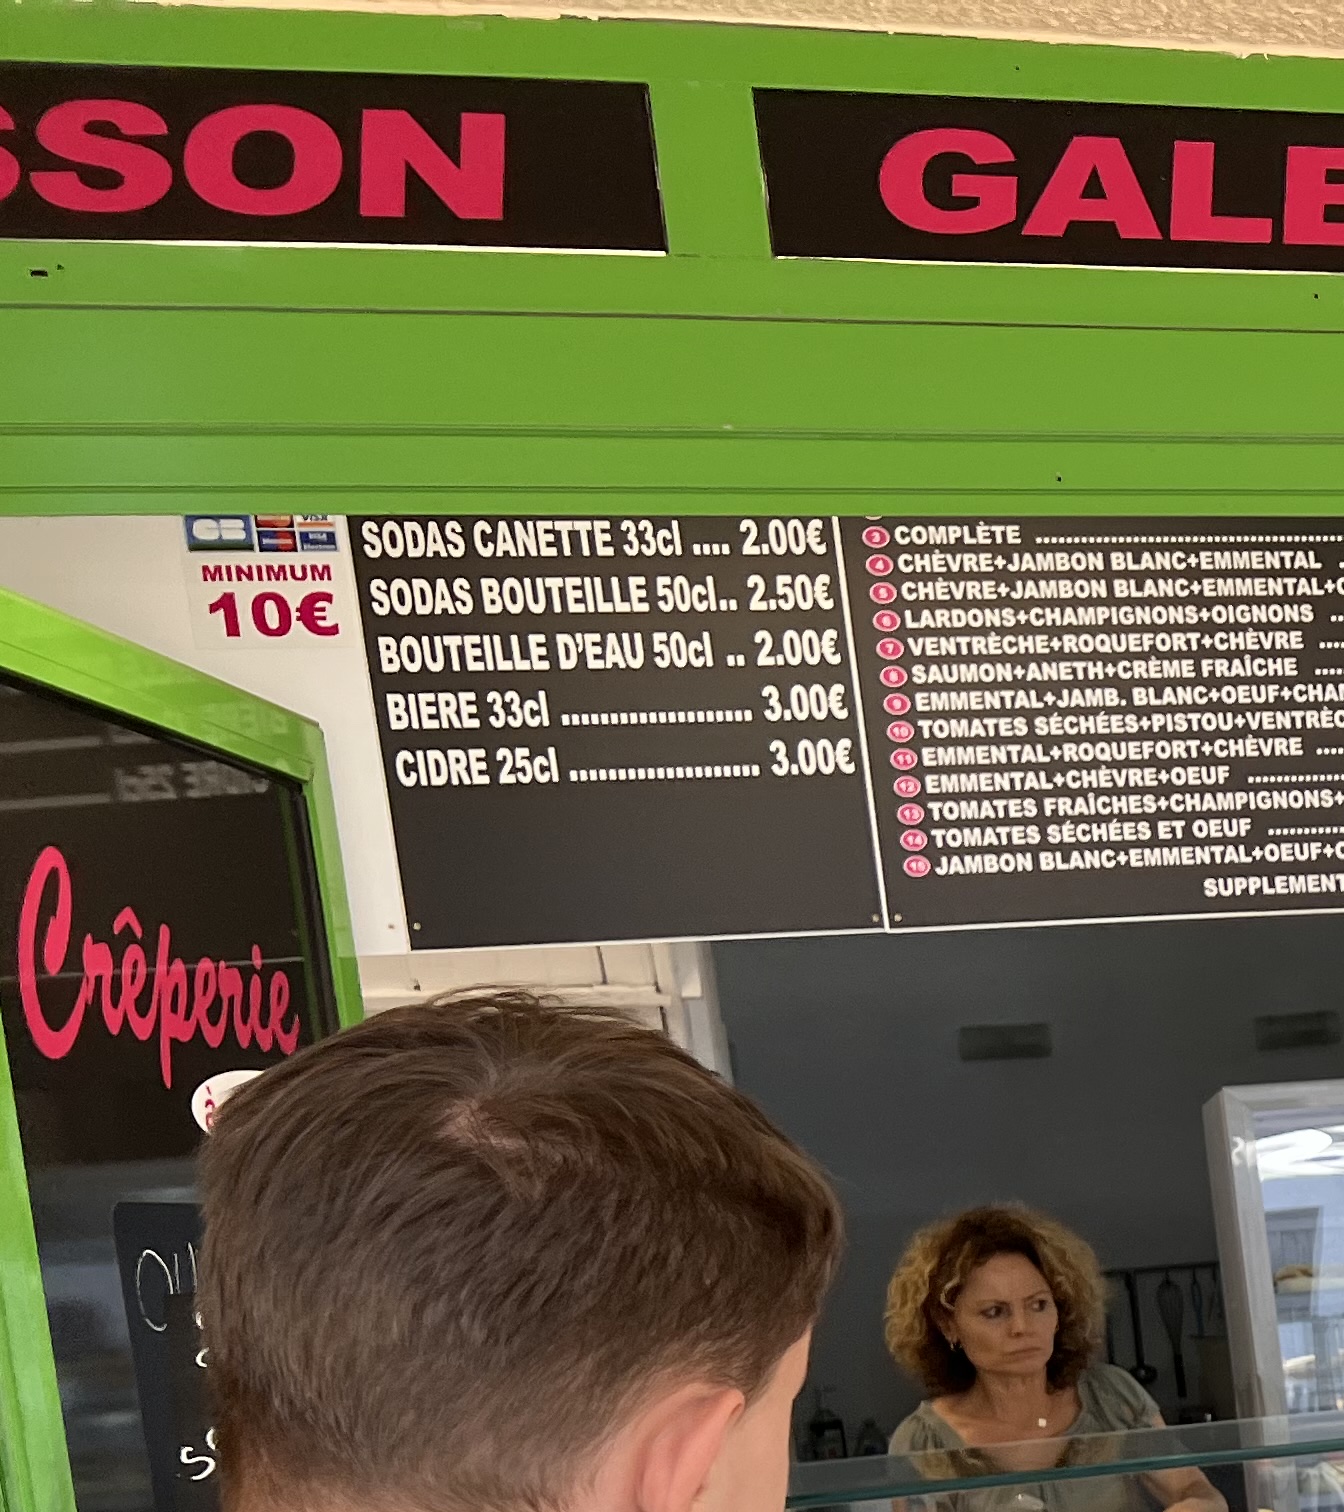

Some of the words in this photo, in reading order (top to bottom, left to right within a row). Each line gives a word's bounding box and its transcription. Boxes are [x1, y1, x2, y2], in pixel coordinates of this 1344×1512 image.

[0, 98, 505, 220] SON
[362, 521, 465, 558] SODAS
[474, 520, 614, 557] CANETTE
[621, 520, 682, 556] 33cl
[740, 519, 826, 555] 2.00€
[895, 521, 1021, 544] COMPLÈTE
[202, 564, 332, 582] MINIMUM
[898, 549, 1104, 573] CHÈVRE+JAMBON
[1110, 551, 1322, 570] BLANC+EMMENTAL
[370, 578, 473, 615] SODAS
[481, 577, 649, 614] BOUTEILLE
[747, 574, 834, 610] 2.50€
[208, 592, 340, 637] 10€
[905, 604, 1314, 628] LARDONS+CHAMPIGNONS+OIGNONS
[378, 634, 550, 673] BOUTEILLE
[653, 632, 713, 668] 50cl
[754, 629, 841, 666] 2.00€
[386, 692, 480, 730] BIERE
[487, 691, 549, 728] 33cl
[762, 684, 848, 721] 3.00€
[915, 688, 1126, 711] EMMENTAL+JAMB.
[396, 749, 490, 786] CIDRE
[496, 747, 559, 783] 25cl
[770, 738, 855, 776] 3.00€
[930, 825, 1041, 848] TOMATES
[1158, 820, 1185, 839] ET
[1192, 818, 1251, 838] OEUF
[935, 853, 1033, 875] JAMBON
[18, 846, 300, 1089] Crêperie
